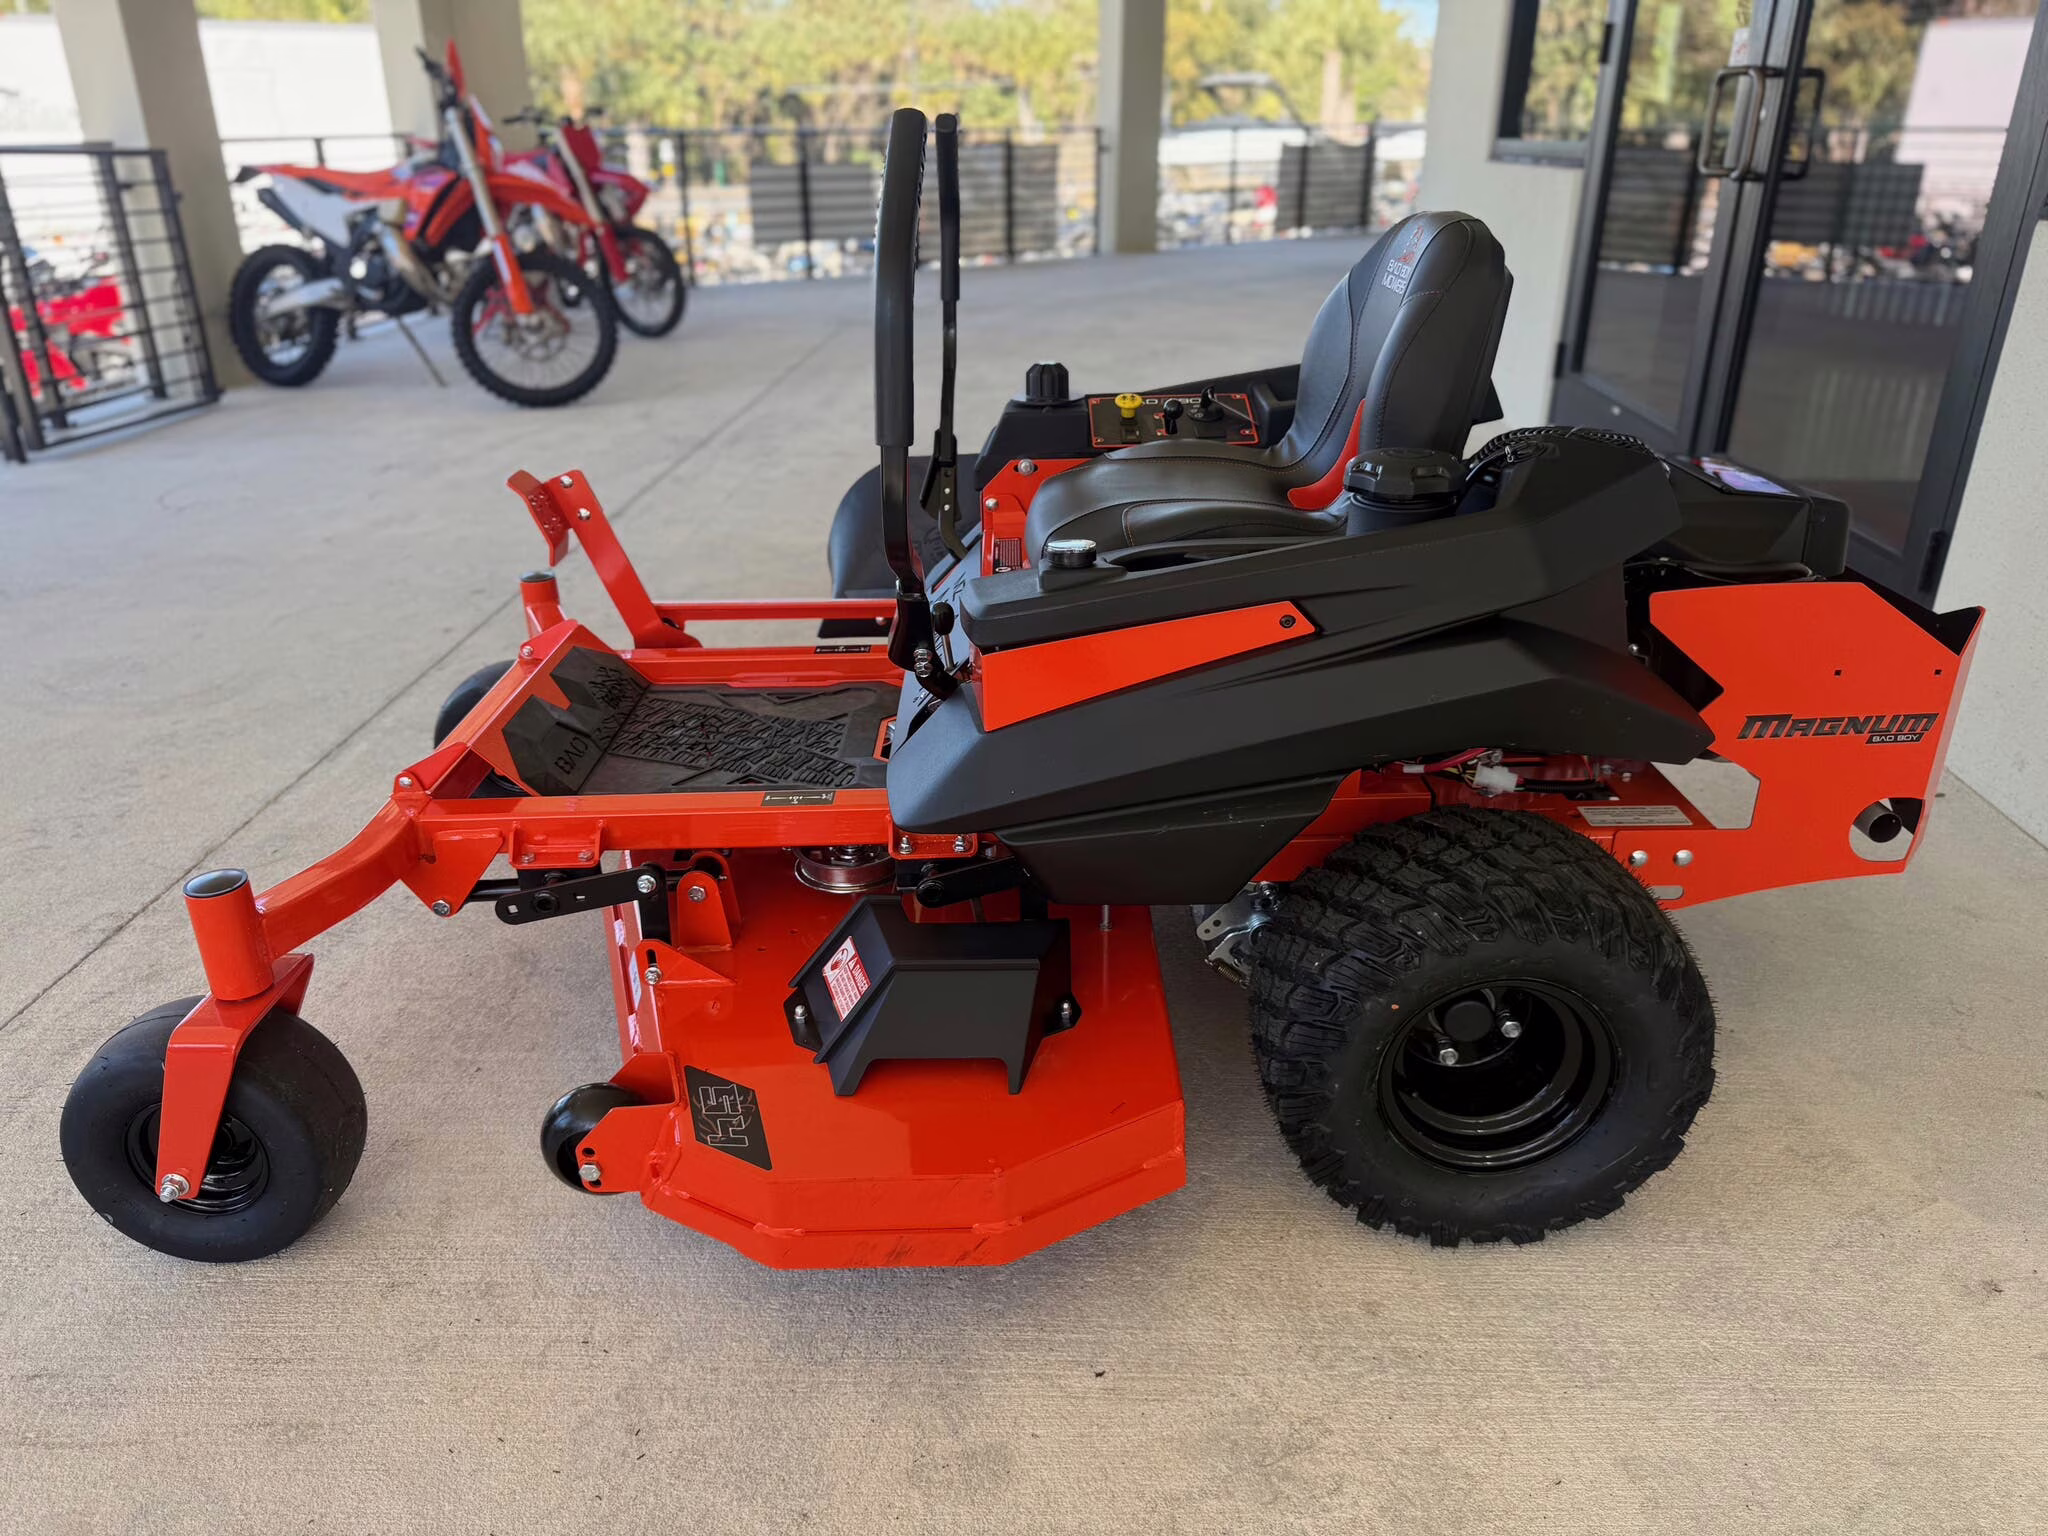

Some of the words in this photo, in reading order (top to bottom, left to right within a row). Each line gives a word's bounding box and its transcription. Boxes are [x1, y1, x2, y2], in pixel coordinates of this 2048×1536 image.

[1736, 713, 1940, 740] MAGNUM
[1871, 735, 1895, 743] BAD
[1897, 734, 1920, 742] BOY
